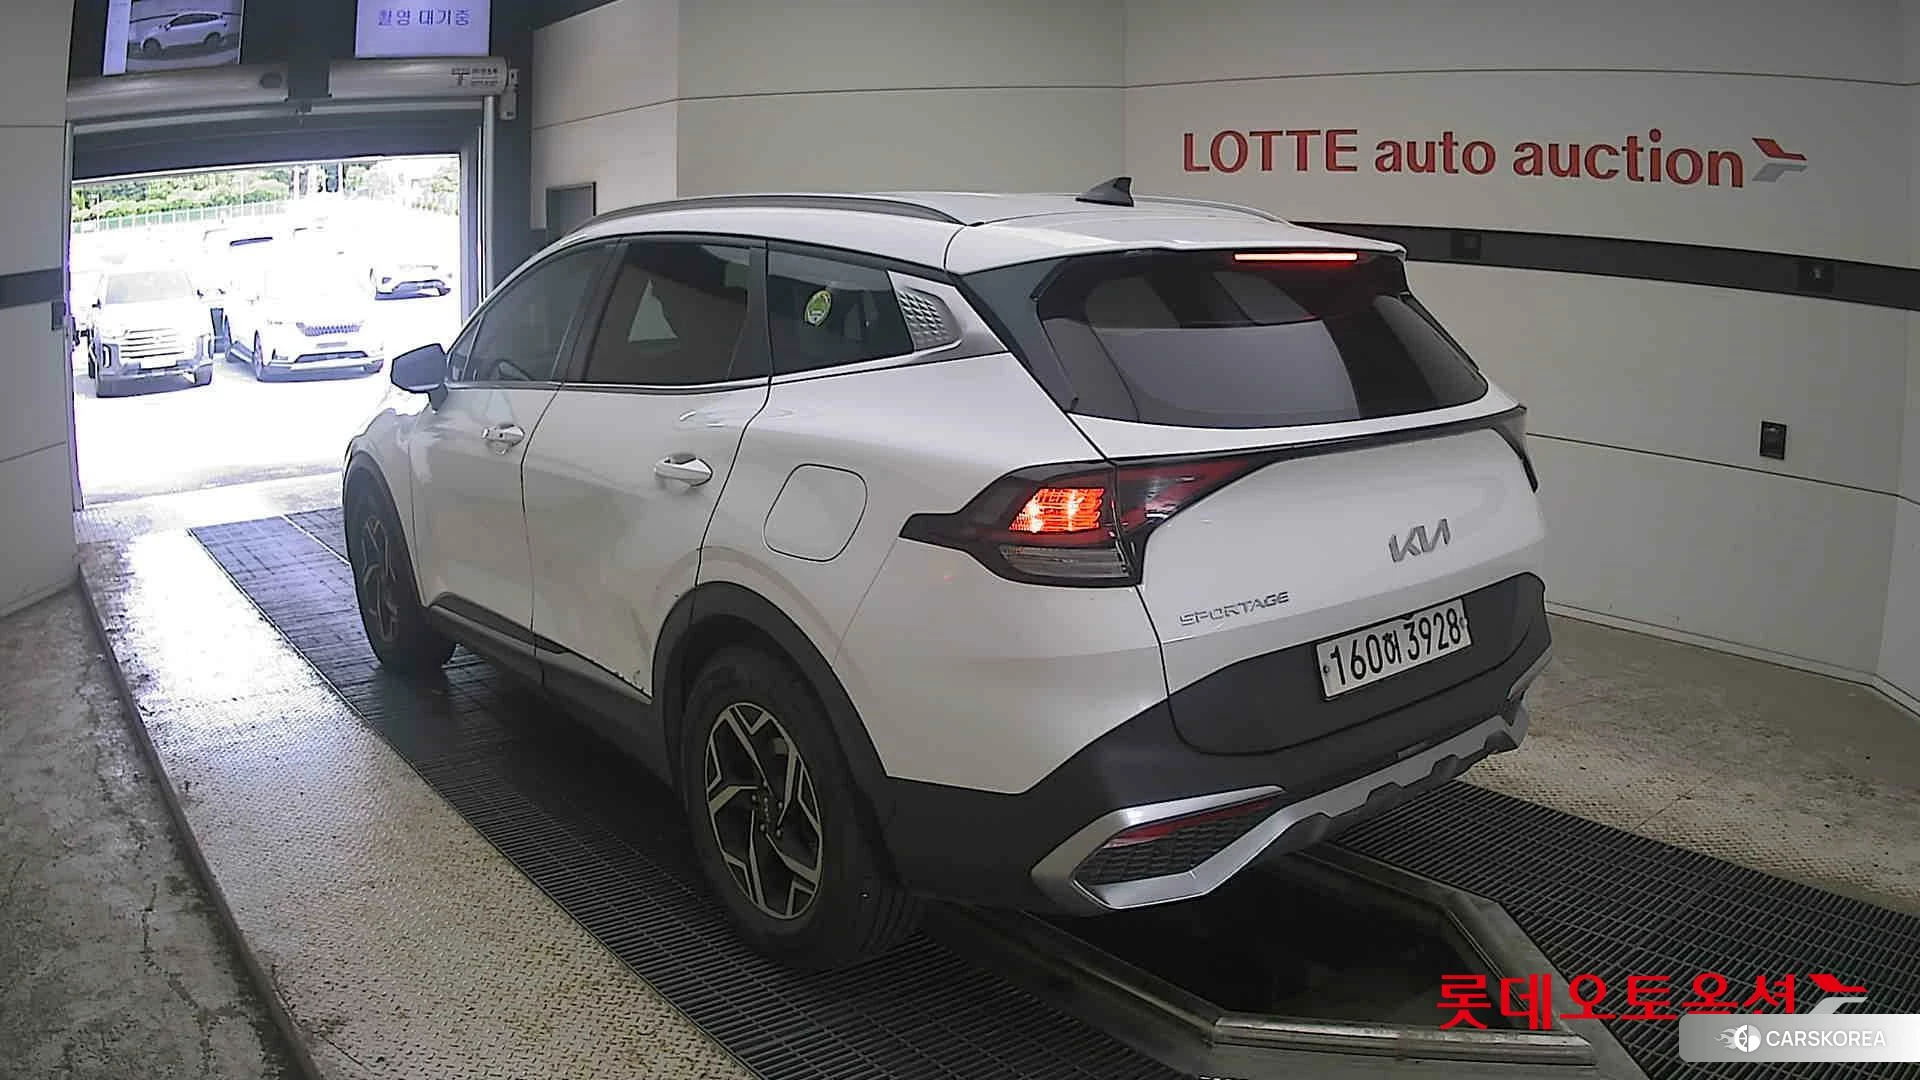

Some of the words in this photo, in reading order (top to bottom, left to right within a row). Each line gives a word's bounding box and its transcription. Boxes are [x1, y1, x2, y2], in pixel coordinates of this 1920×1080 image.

[419, 8, 470, 26] 대기중
[1183, 129, 1358, 173] LOTTE
[1375, 131, 1496, 176] auto
[1513, 128, 1744, 188] auction
[1178, 591, 1290, 626] SPORTAGE
